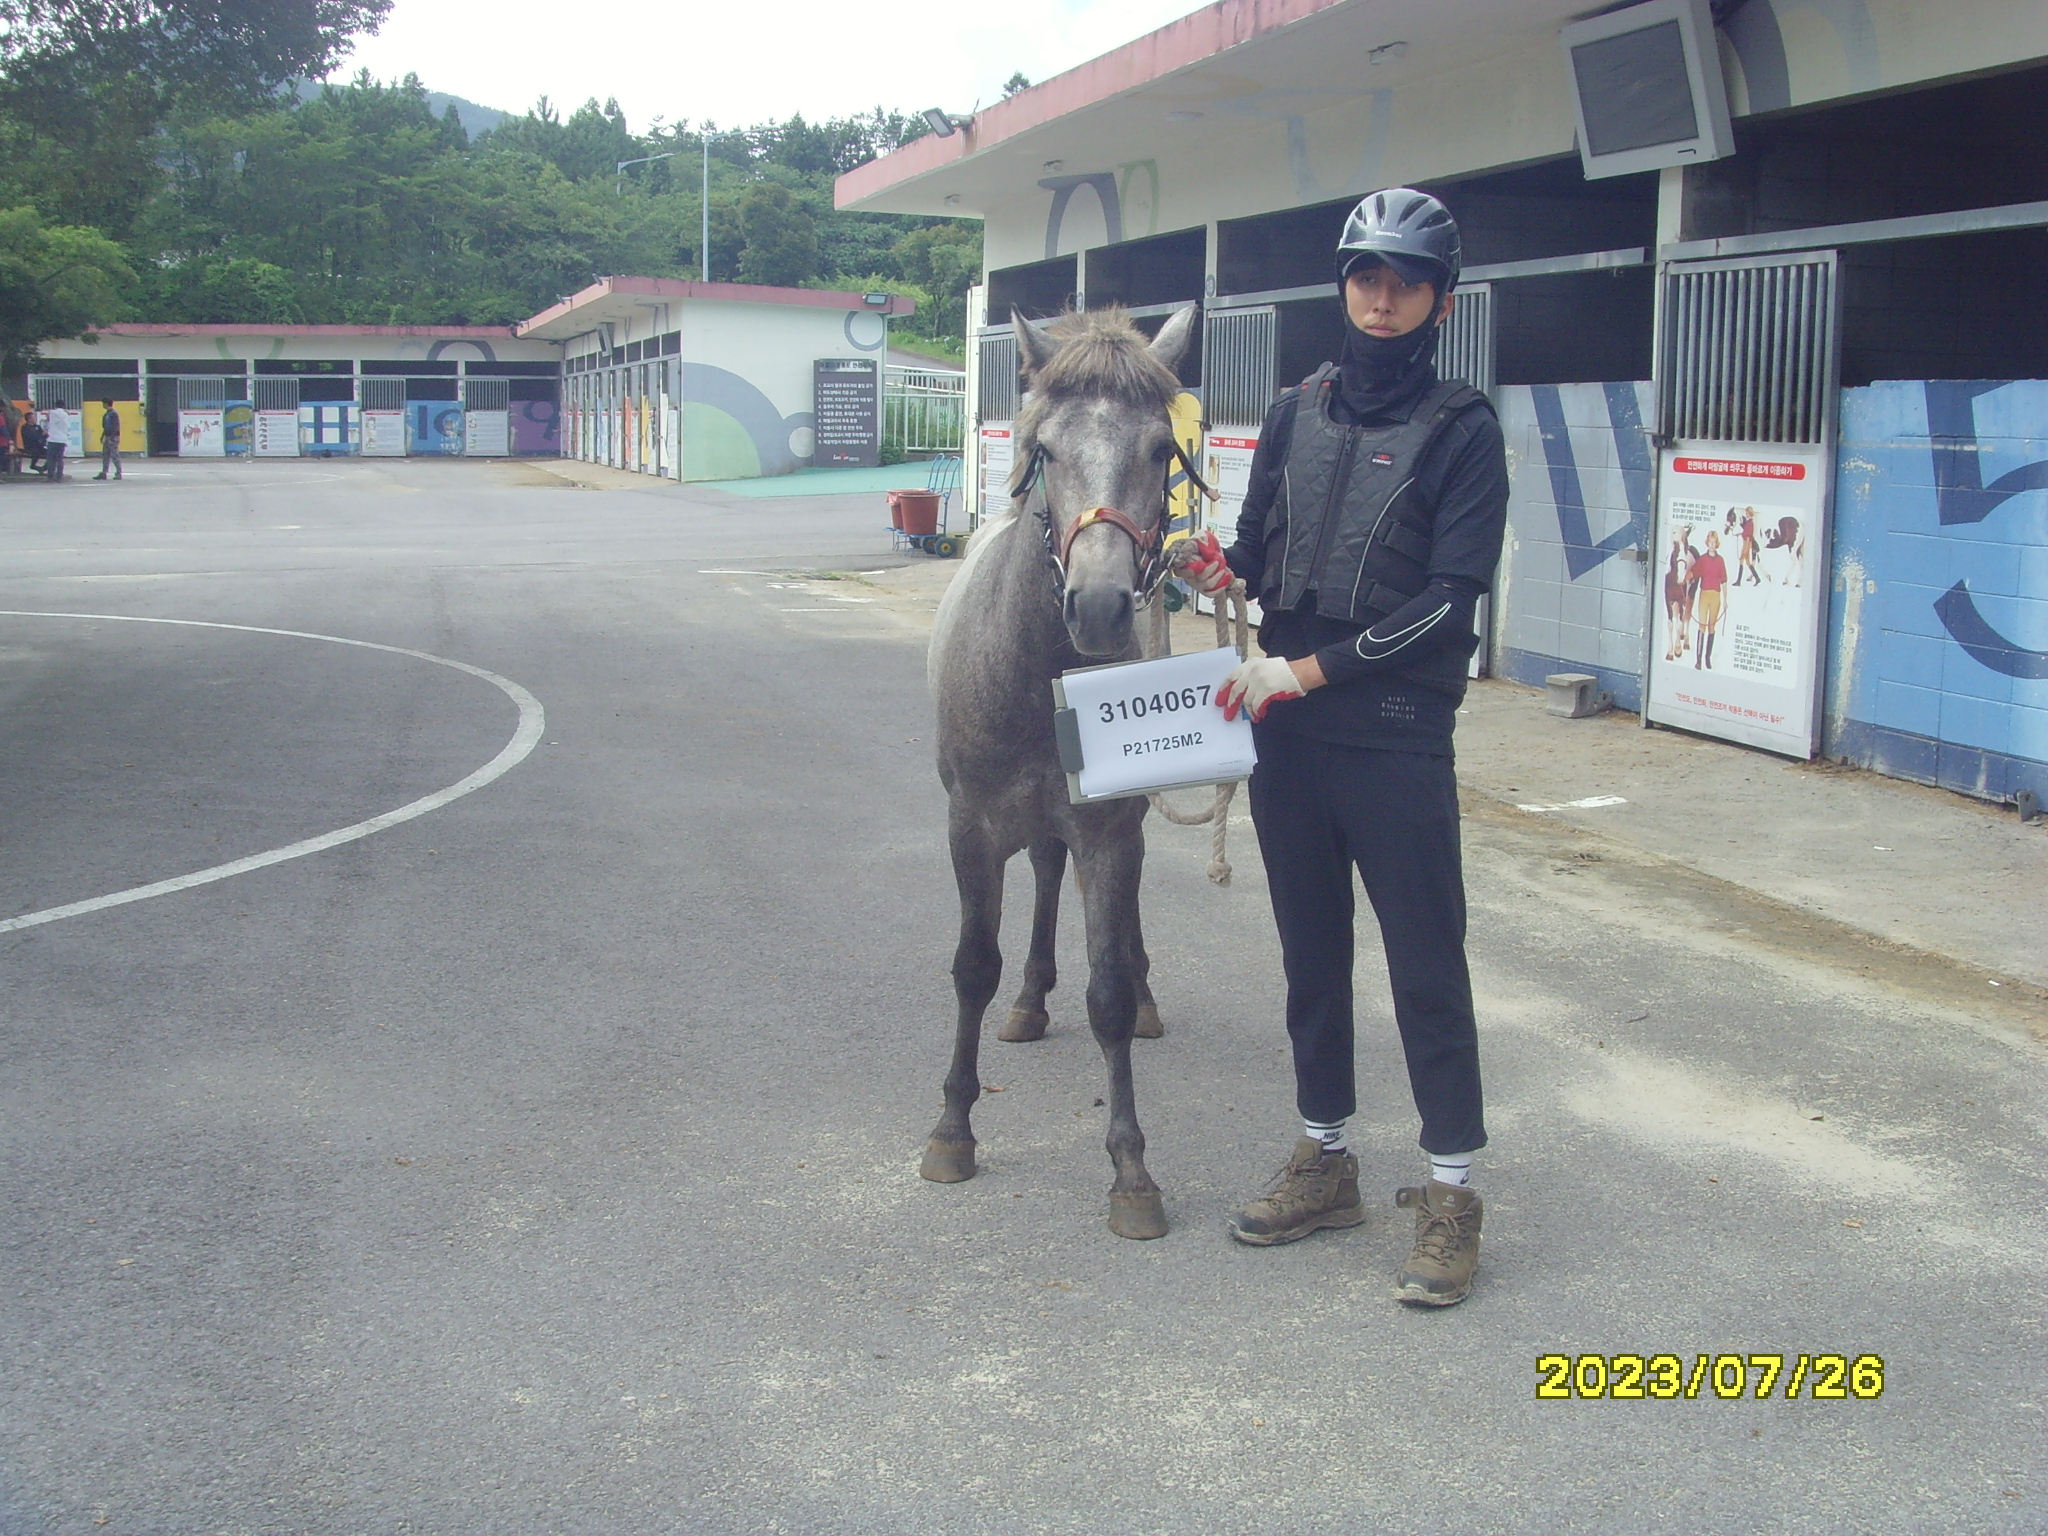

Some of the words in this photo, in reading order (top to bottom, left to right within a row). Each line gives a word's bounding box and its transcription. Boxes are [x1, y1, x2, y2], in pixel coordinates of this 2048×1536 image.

[1687, 460, 1708, 471] 안전하게
[1770, 465, 1793, 476] 이동하기
[1099, 684, 1211, 723] 3104067
[1123, 732, 1203, 756] P21725M2
